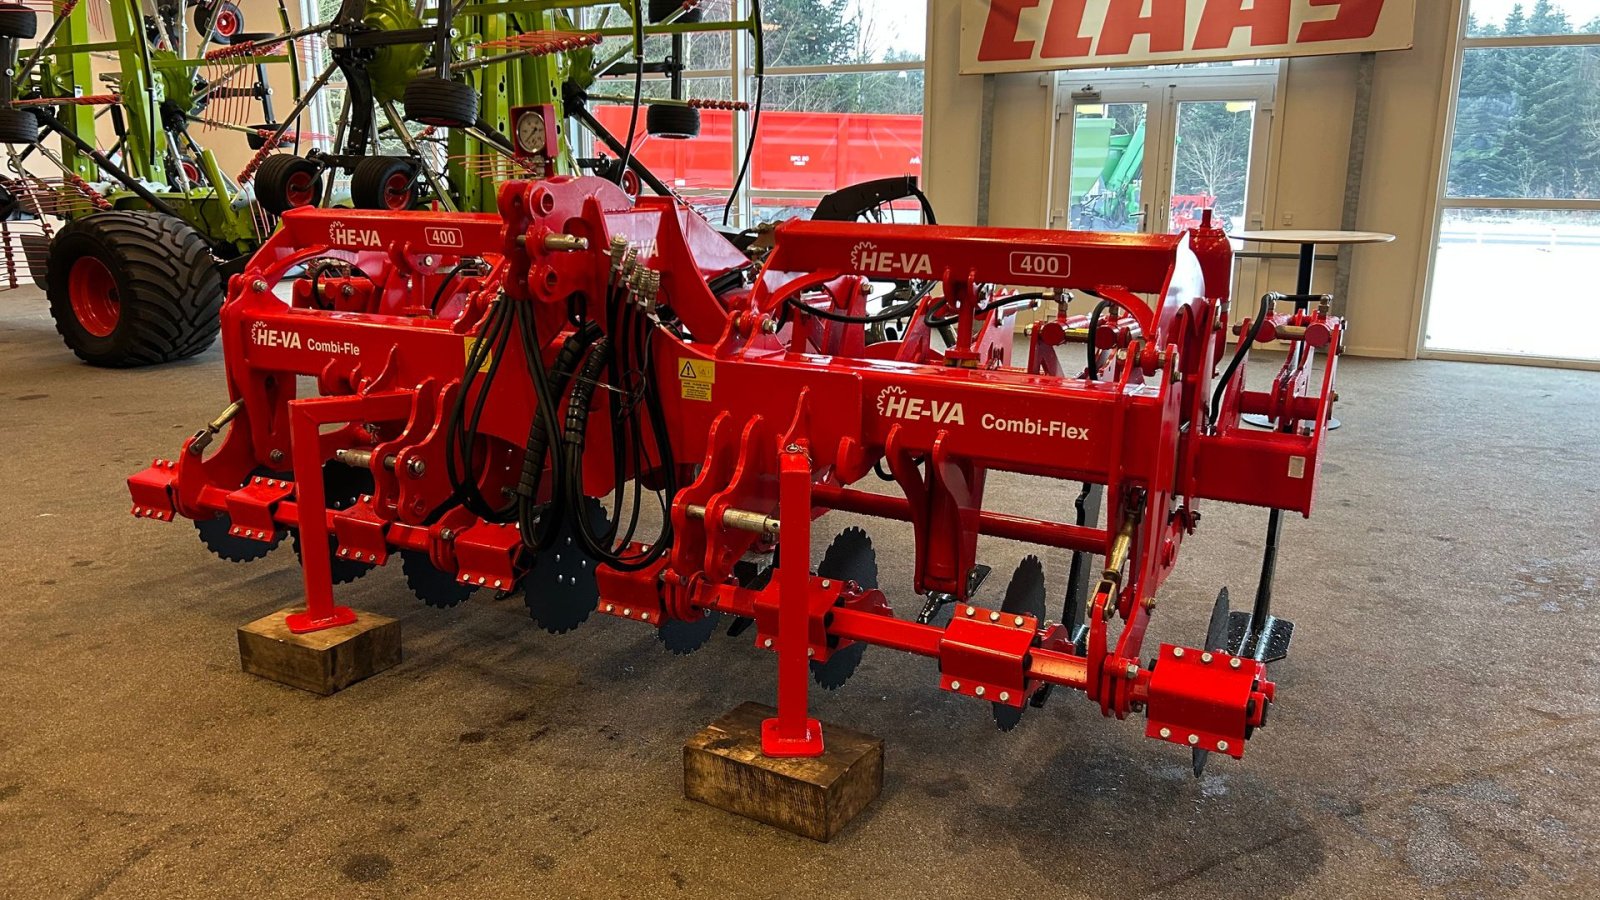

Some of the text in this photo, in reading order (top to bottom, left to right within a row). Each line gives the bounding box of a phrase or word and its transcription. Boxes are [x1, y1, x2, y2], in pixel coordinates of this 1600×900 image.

[335, 228, 382, 247] HE-VA
[432, 230, 456, 245] 400
[859, 250, 933, 275] HE-VA
[1020, 255, 1060, 274] 400
[257, 328, 361, 356] HE-VA Combi-Fle
[884, 395, 1090, 441] HE-VA Combi-Flex
